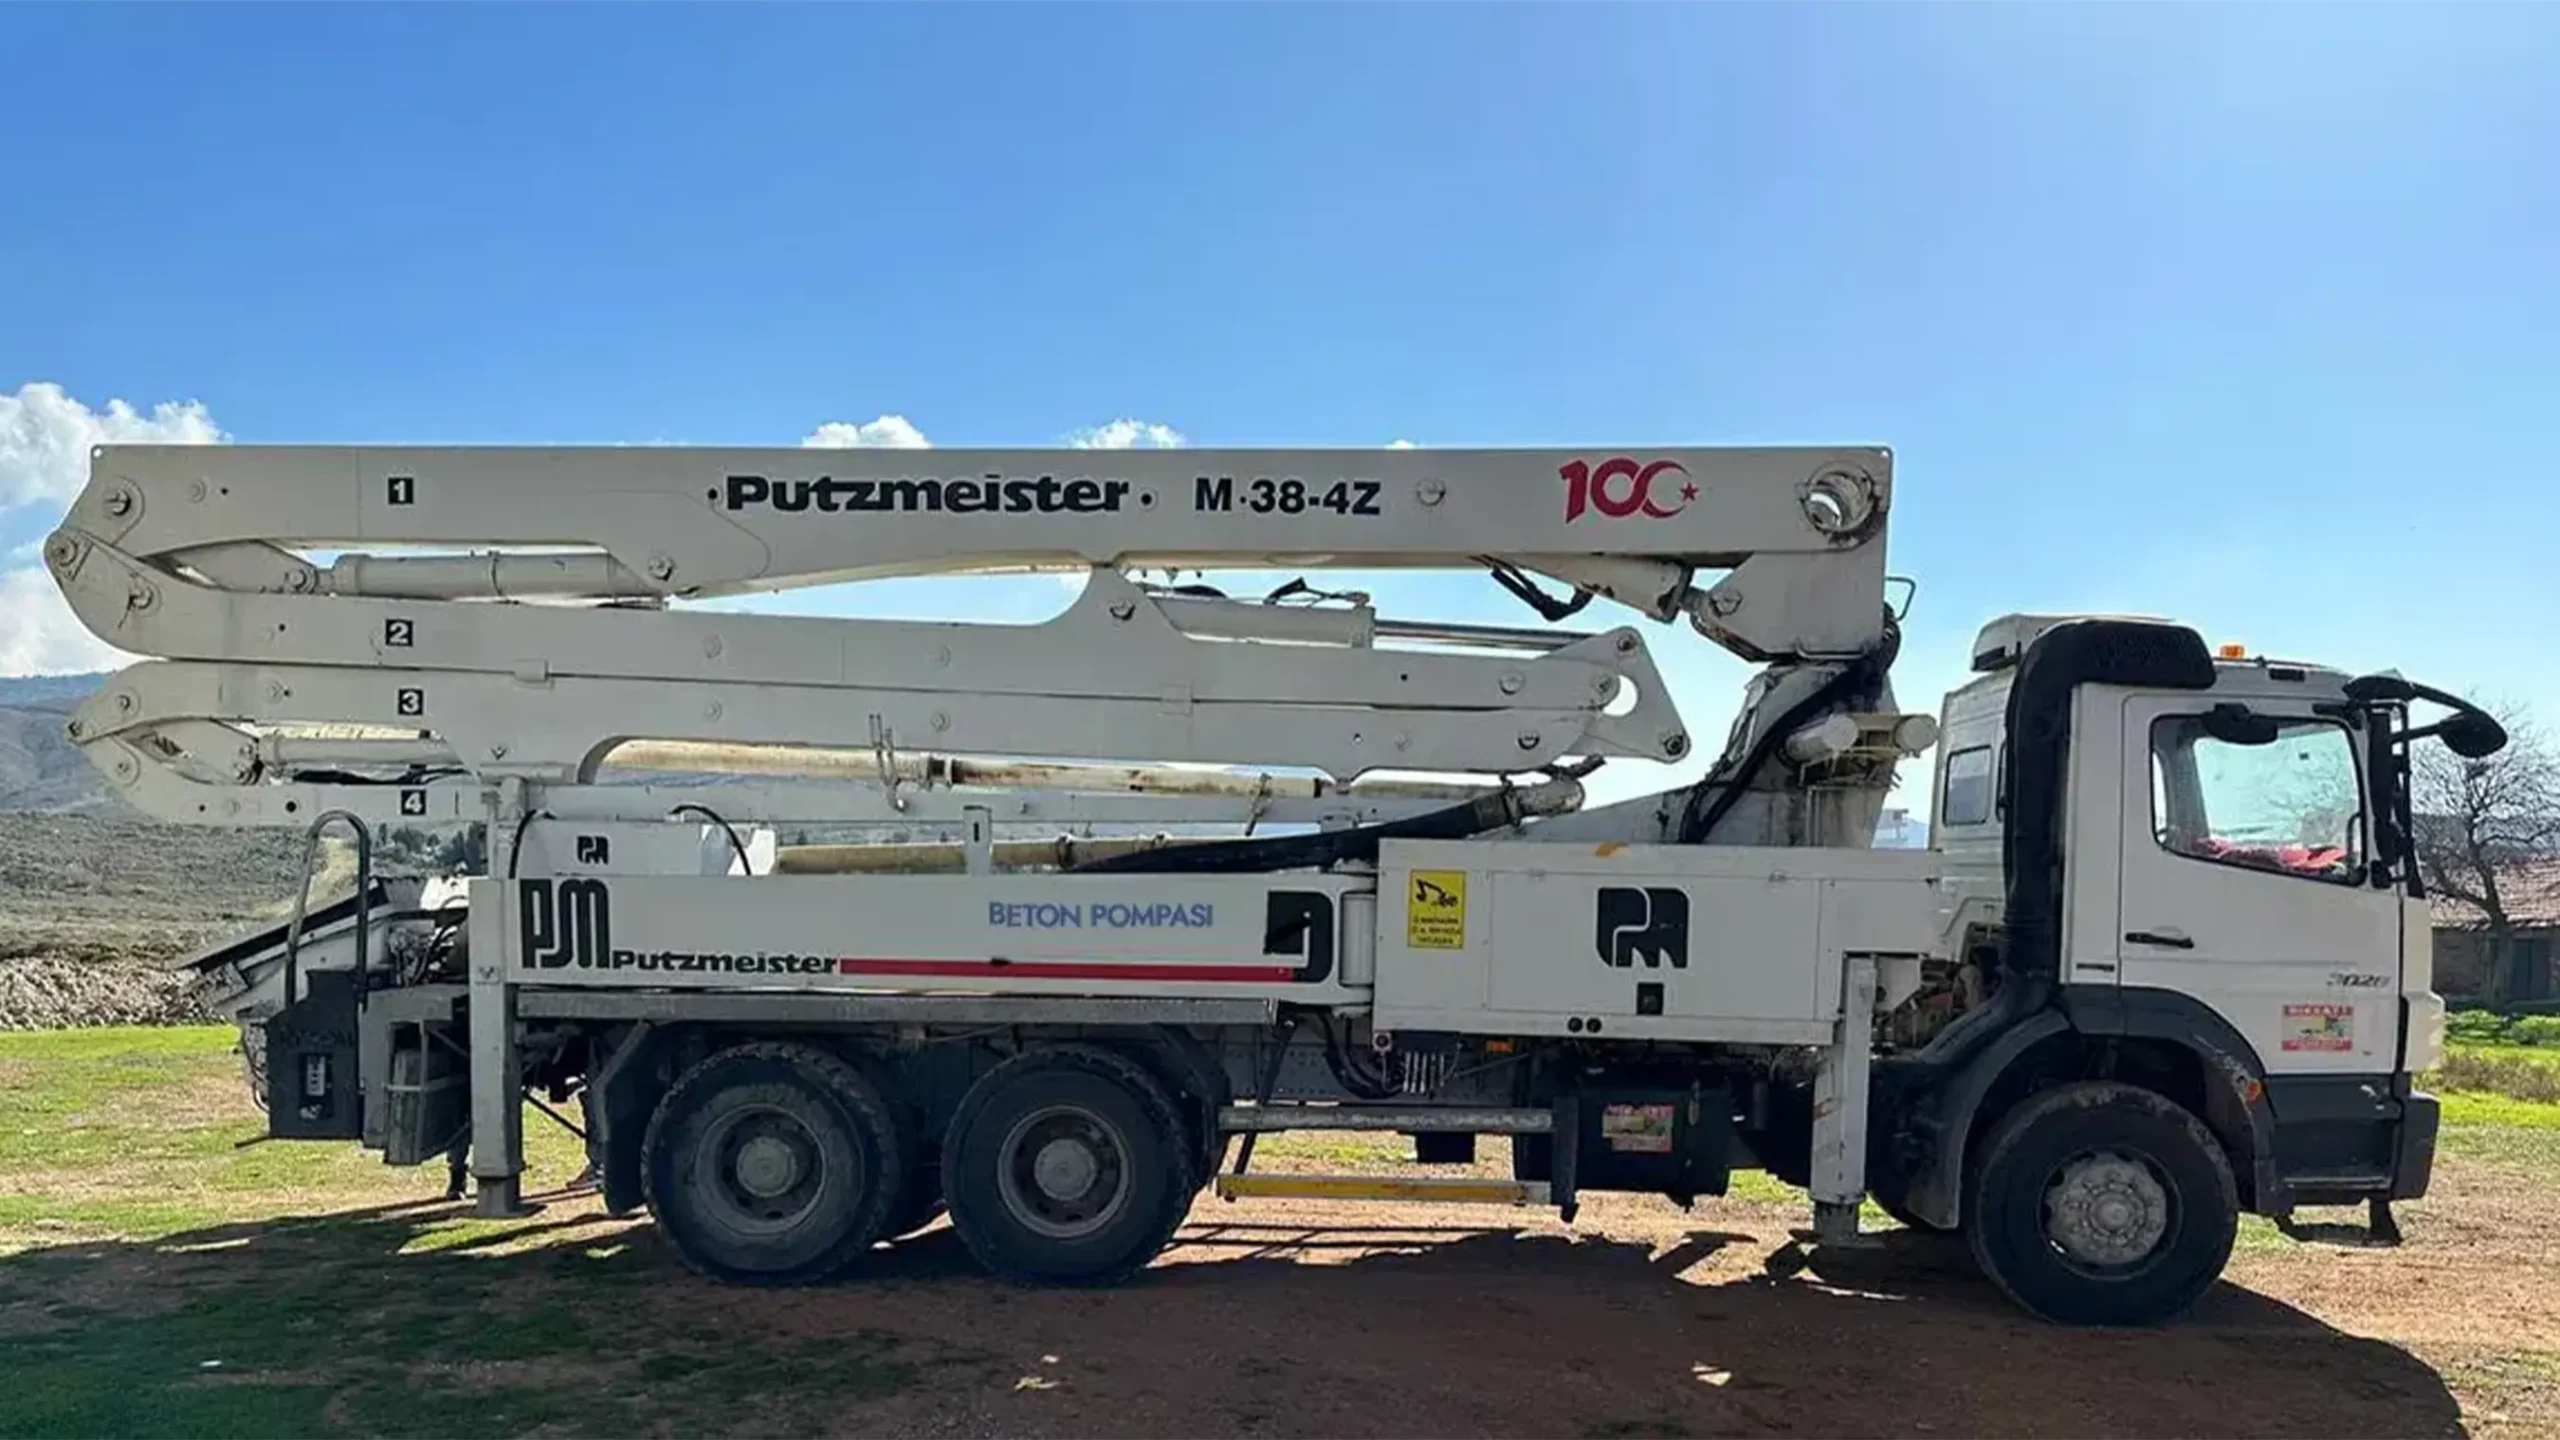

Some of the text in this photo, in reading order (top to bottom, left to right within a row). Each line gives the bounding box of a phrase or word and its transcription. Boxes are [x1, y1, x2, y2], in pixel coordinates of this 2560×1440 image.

[392, 479, 407, 502] 1
[727, 475, 1129, 512] Putzmeister
[388, 621, 409, 645] 2
[401, 690, 420, 713] 3
[404, 792, 422, 813] 4
[988, 902, 1213, 928] BETON POMPASI
[612, 951, 837, 974] Putzmeister
